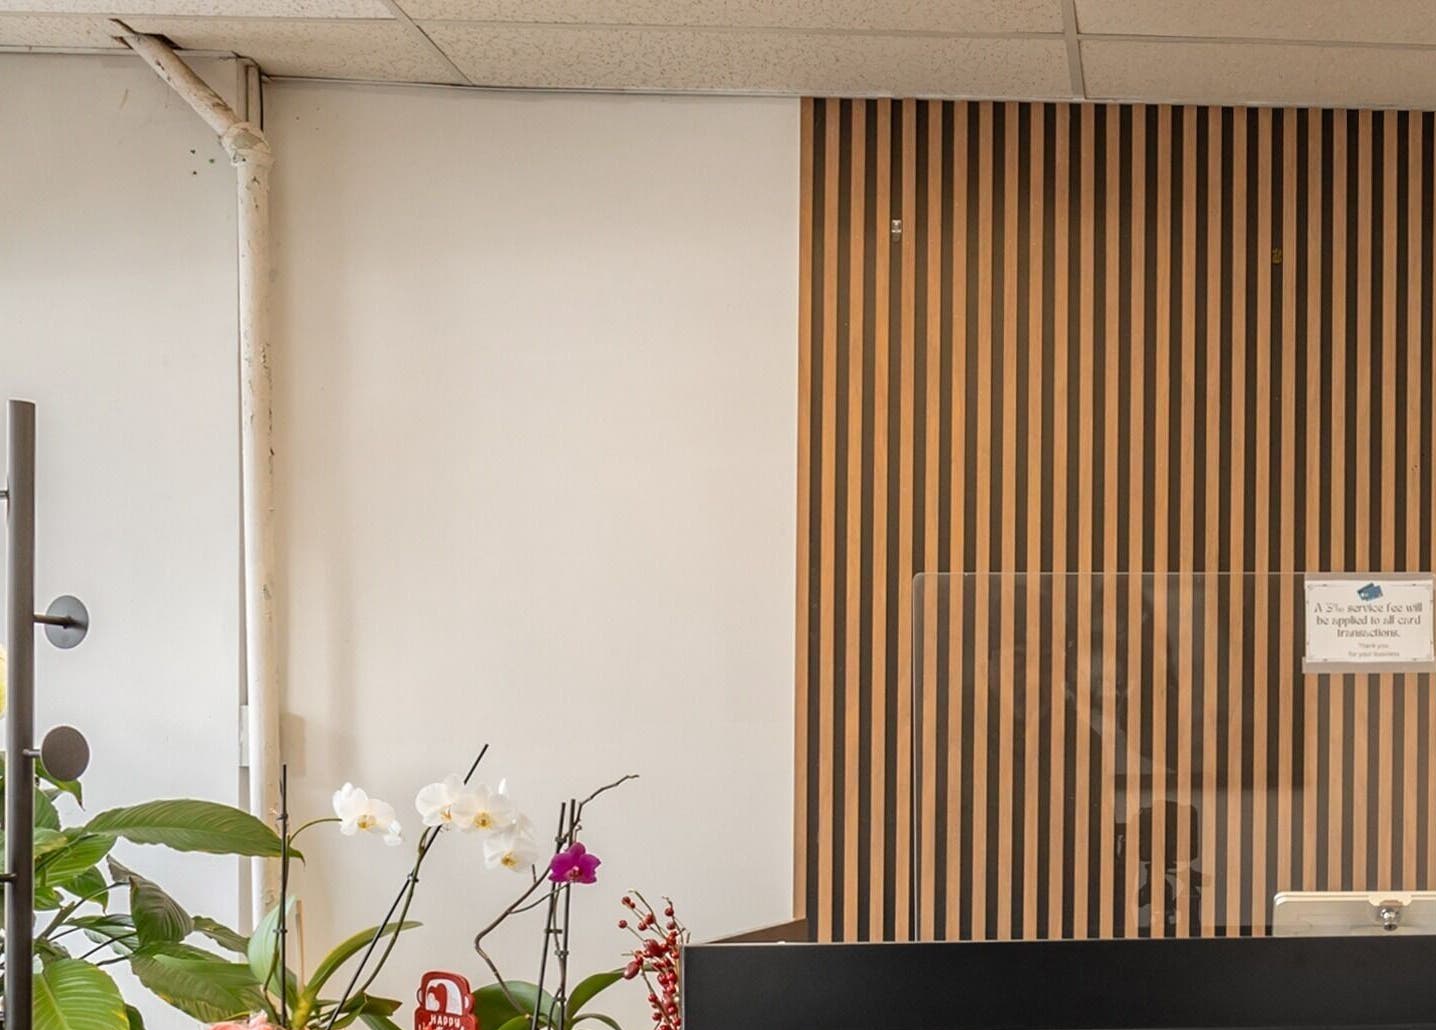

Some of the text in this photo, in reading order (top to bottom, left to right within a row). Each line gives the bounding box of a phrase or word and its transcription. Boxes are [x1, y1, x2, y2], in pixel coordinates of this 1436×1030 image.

[1314, 602, 1323, 613] A
[1347, 602, 1384, 613] service
[1386, 601, 1403, 613] fee
[1405, 602, 1423, 613] will
[1316, 614, 1421, 627] be applied to all card
[430, 1014, 461, 1028] HAPPY
